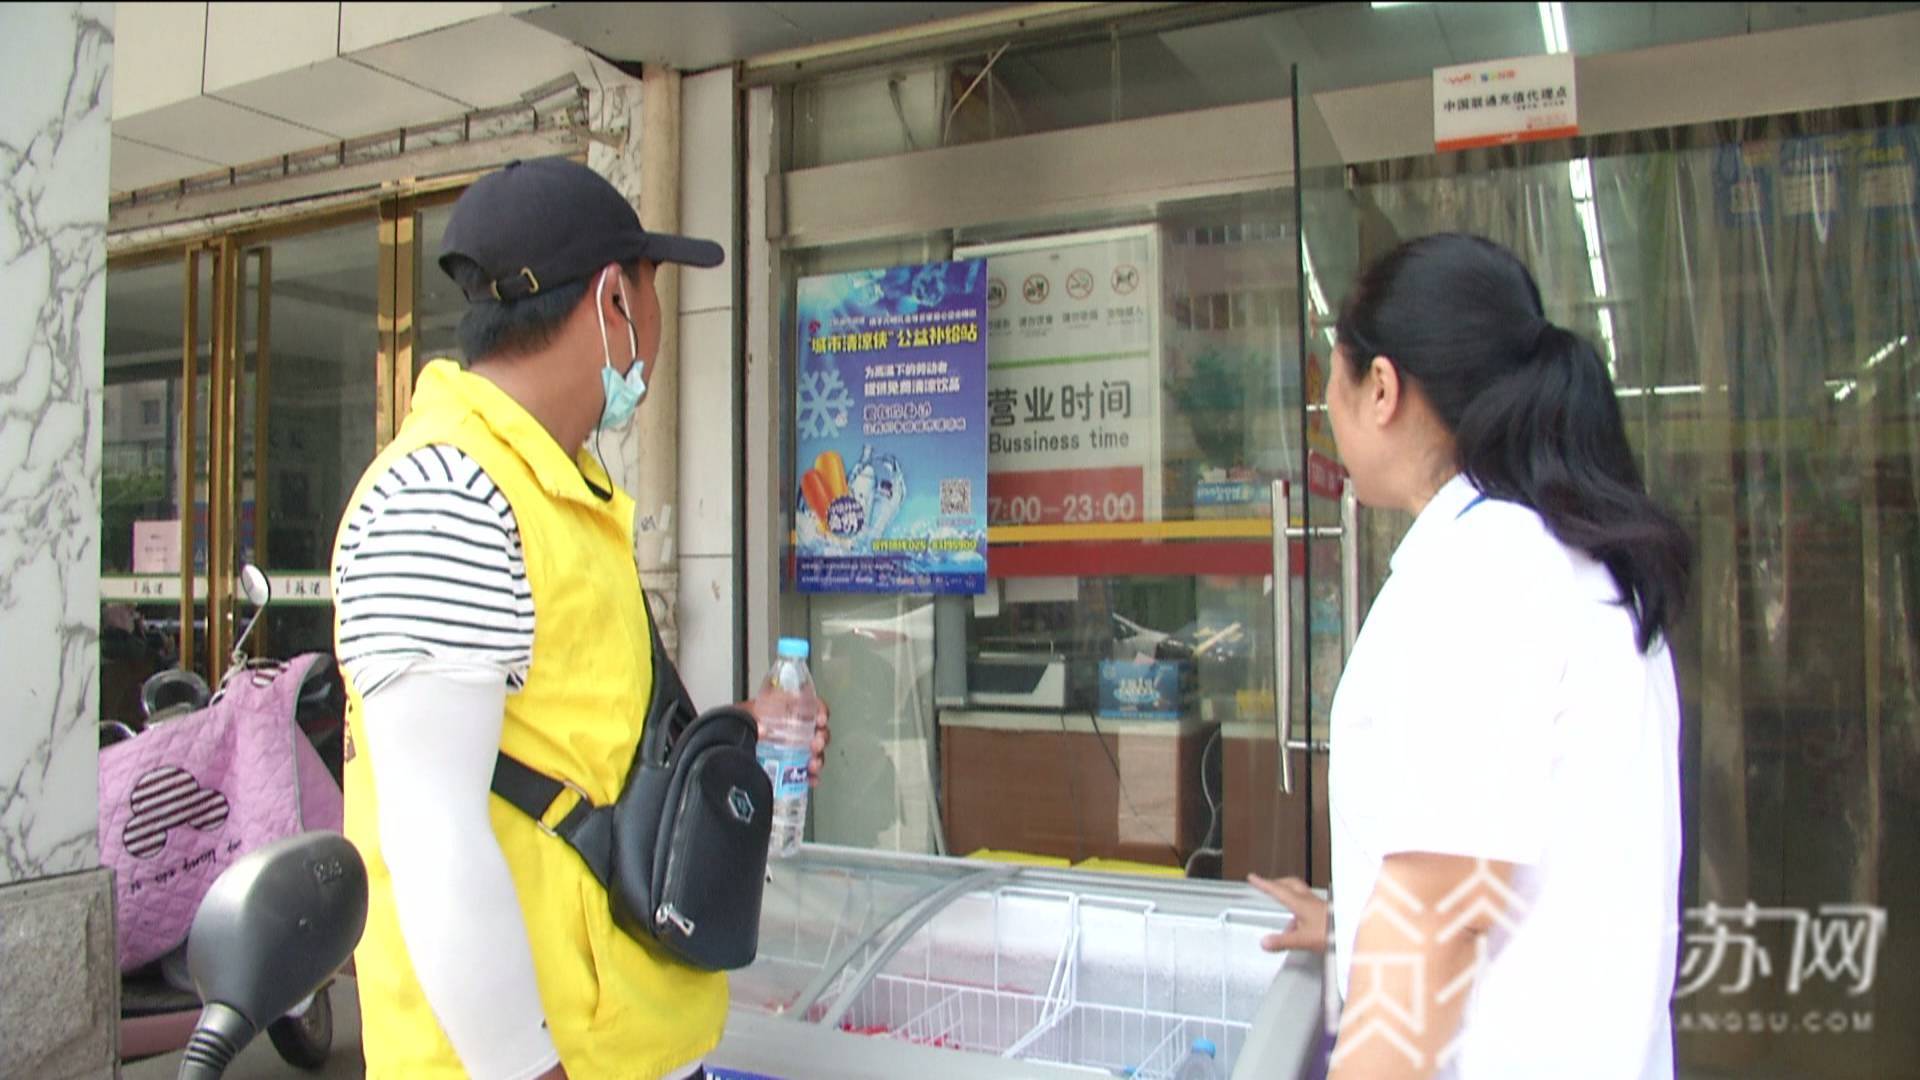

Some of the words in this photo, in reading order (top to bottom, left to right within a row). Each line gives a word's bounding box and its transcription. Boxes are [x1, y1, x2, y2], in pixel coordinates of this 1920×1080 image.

[1443, 86, 1567, 112] 中国联通充值代理点
[986, 379, 1132, 427] 营业时间
[988, 430, 1081, 455] Bussiness
[1089, 426, 1130, 450] time
